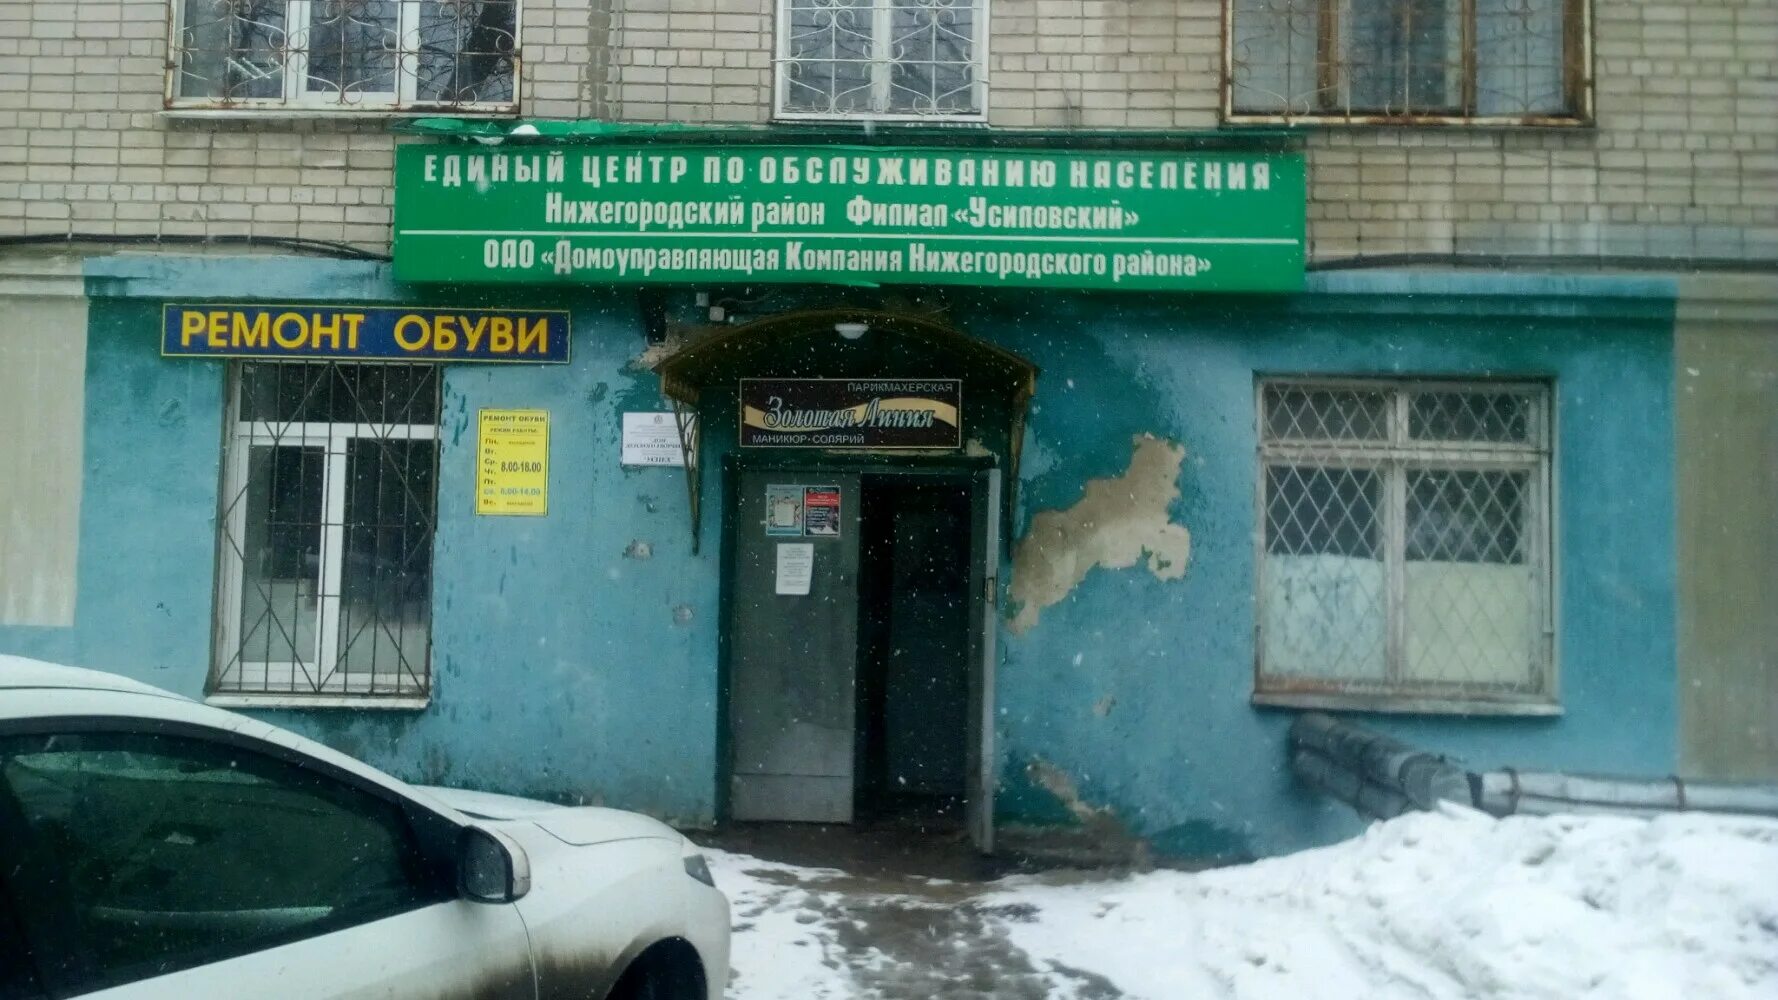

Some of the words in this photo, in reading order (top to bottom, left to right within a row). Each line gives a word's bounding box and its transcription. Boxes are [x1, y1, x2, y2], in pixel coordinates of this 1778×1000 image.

[424, 151, 564, 187] ЕДИНЫЙ
[583, 155, 687, 188] ЦЕНТР
[704, 156, 743, 183] ПО
[759, 157, 1056, 188] ОБСЛУЖИВАНИЮ
[1070, 161, 1271, 190] НАСЕЛЕНИЯ
[545, 192, 745, 232] Нижегородский
[751, 194, 825, 232] район
[846, 194, 948, 228] Филиал
[954, 196, 1140, 229] «Усиловский»
[483, 238, 535, 269] ОАО
[541, 238, 779, 276] «Домоуправляющая
[785, 242, 903, 271] Компания
[908, 243, 1106, 279] Нижегородского
[1113, 249, 1212, 282] района»
[180, 310, 365, 349] РЕМОНТ
[393, 314, 549, 354] ОБУВИ
[847, 382, 953, 392] ПАРИКМАХЕРСКАЯ
[764, 395, 856, 429] Золотая
[858, 396, 935, 429] Линия
[501, 461, 541, 472] 8.00-18.00
